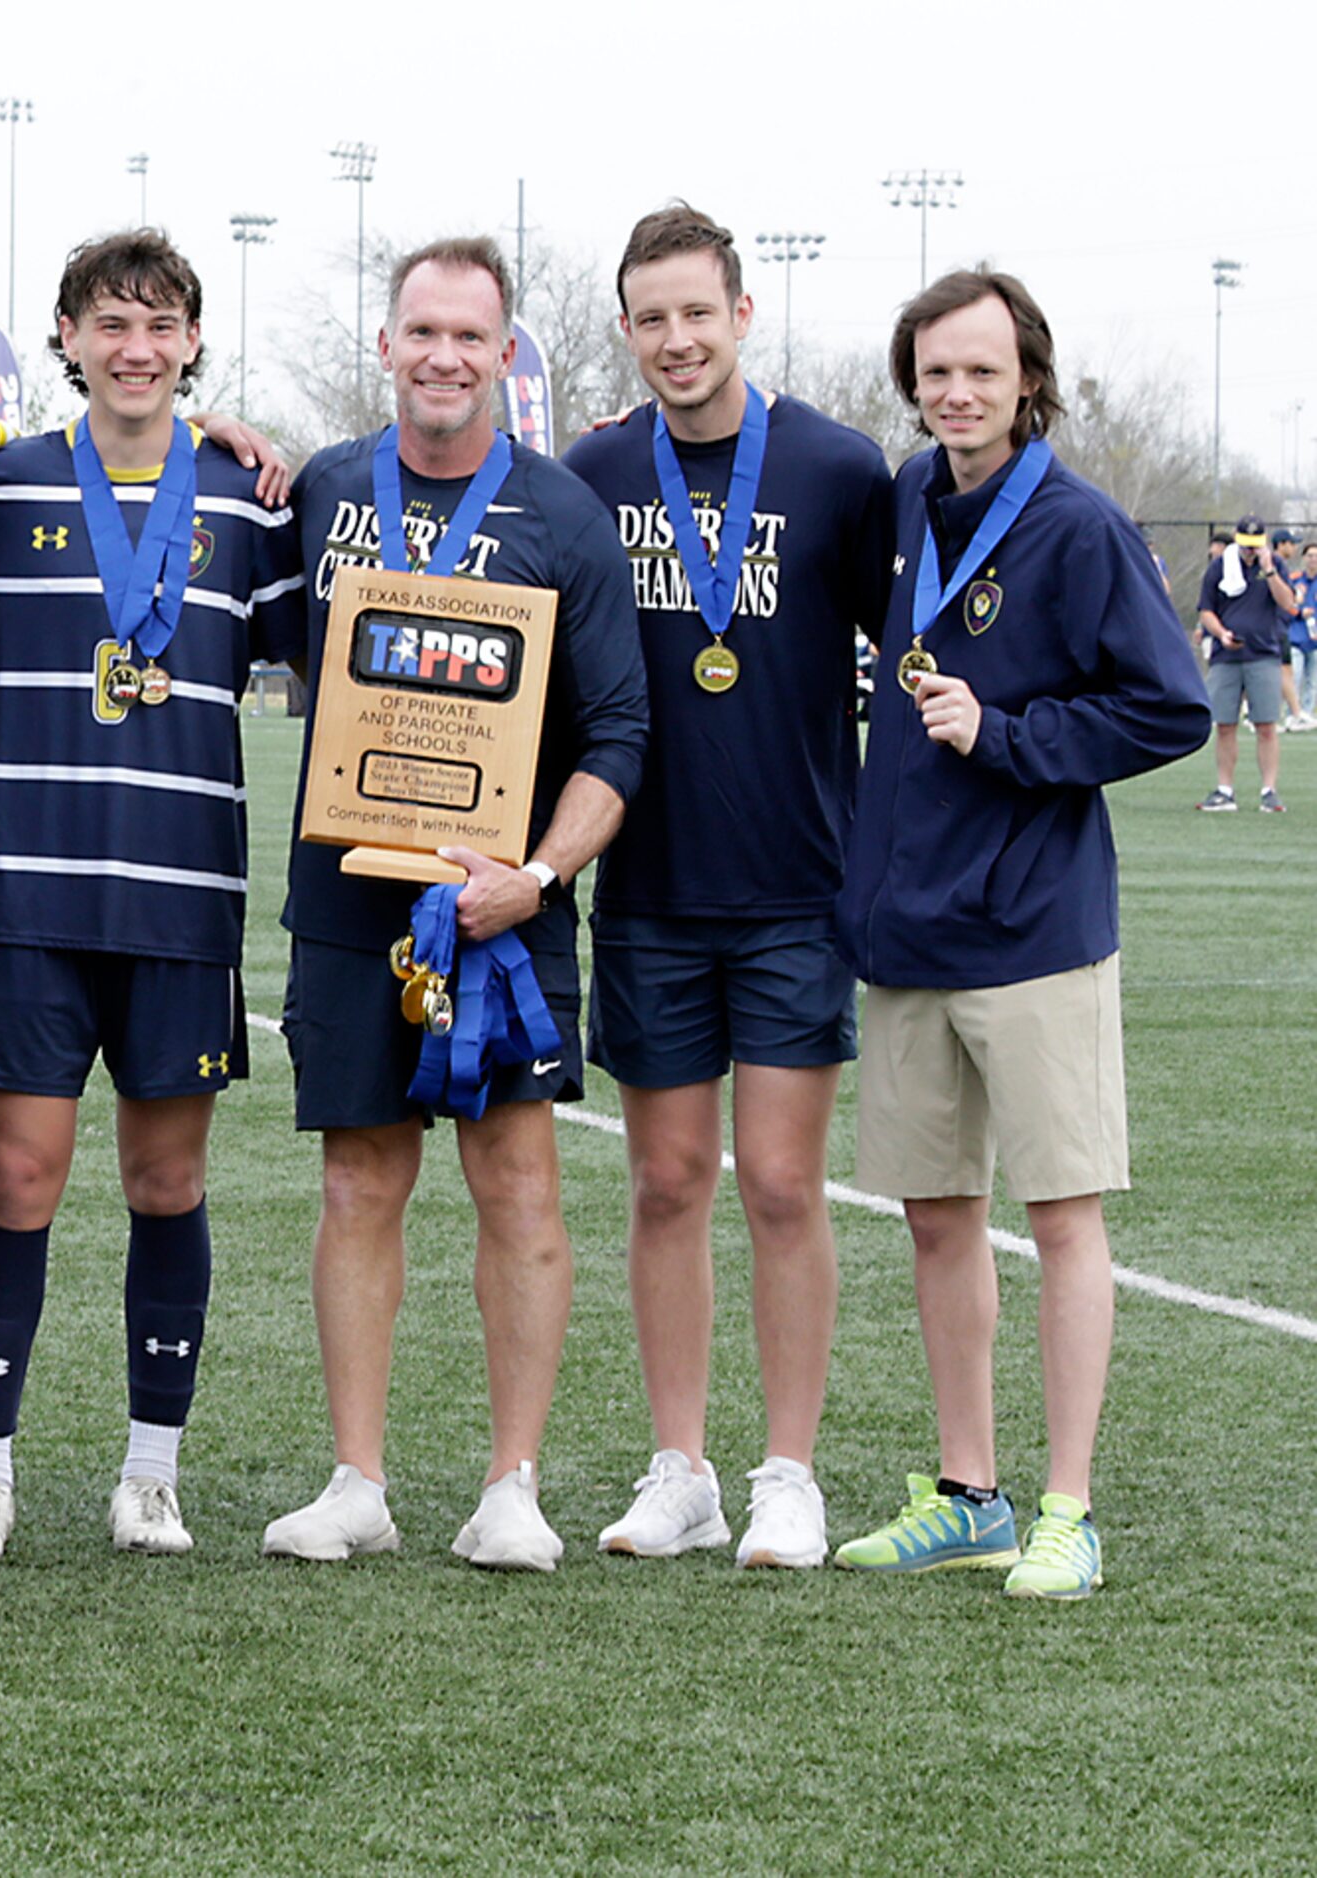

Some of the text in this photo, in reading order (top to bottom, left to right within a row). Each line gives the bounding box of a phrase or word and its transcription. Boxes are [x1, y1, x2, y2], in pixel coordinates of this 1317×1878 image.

[326, 499, 501, 578] DISTRT
[618, 505, 786, 557] DISRT
[357, 587, 532, 621] TEXAS ASSOCIATION
[629, 556, 779, 618] HAMNS
[368, 623, 507, 687] TAPPS
[380, 695, 478, 721] OF PRIVATE
[358, 711, 495, 740] AND PAROCHIAL
[382, 731, 467, 755] SCHOOLS
[370, 770, 401, 783] State
[326, 805, 501, 839] Competition with Honor
